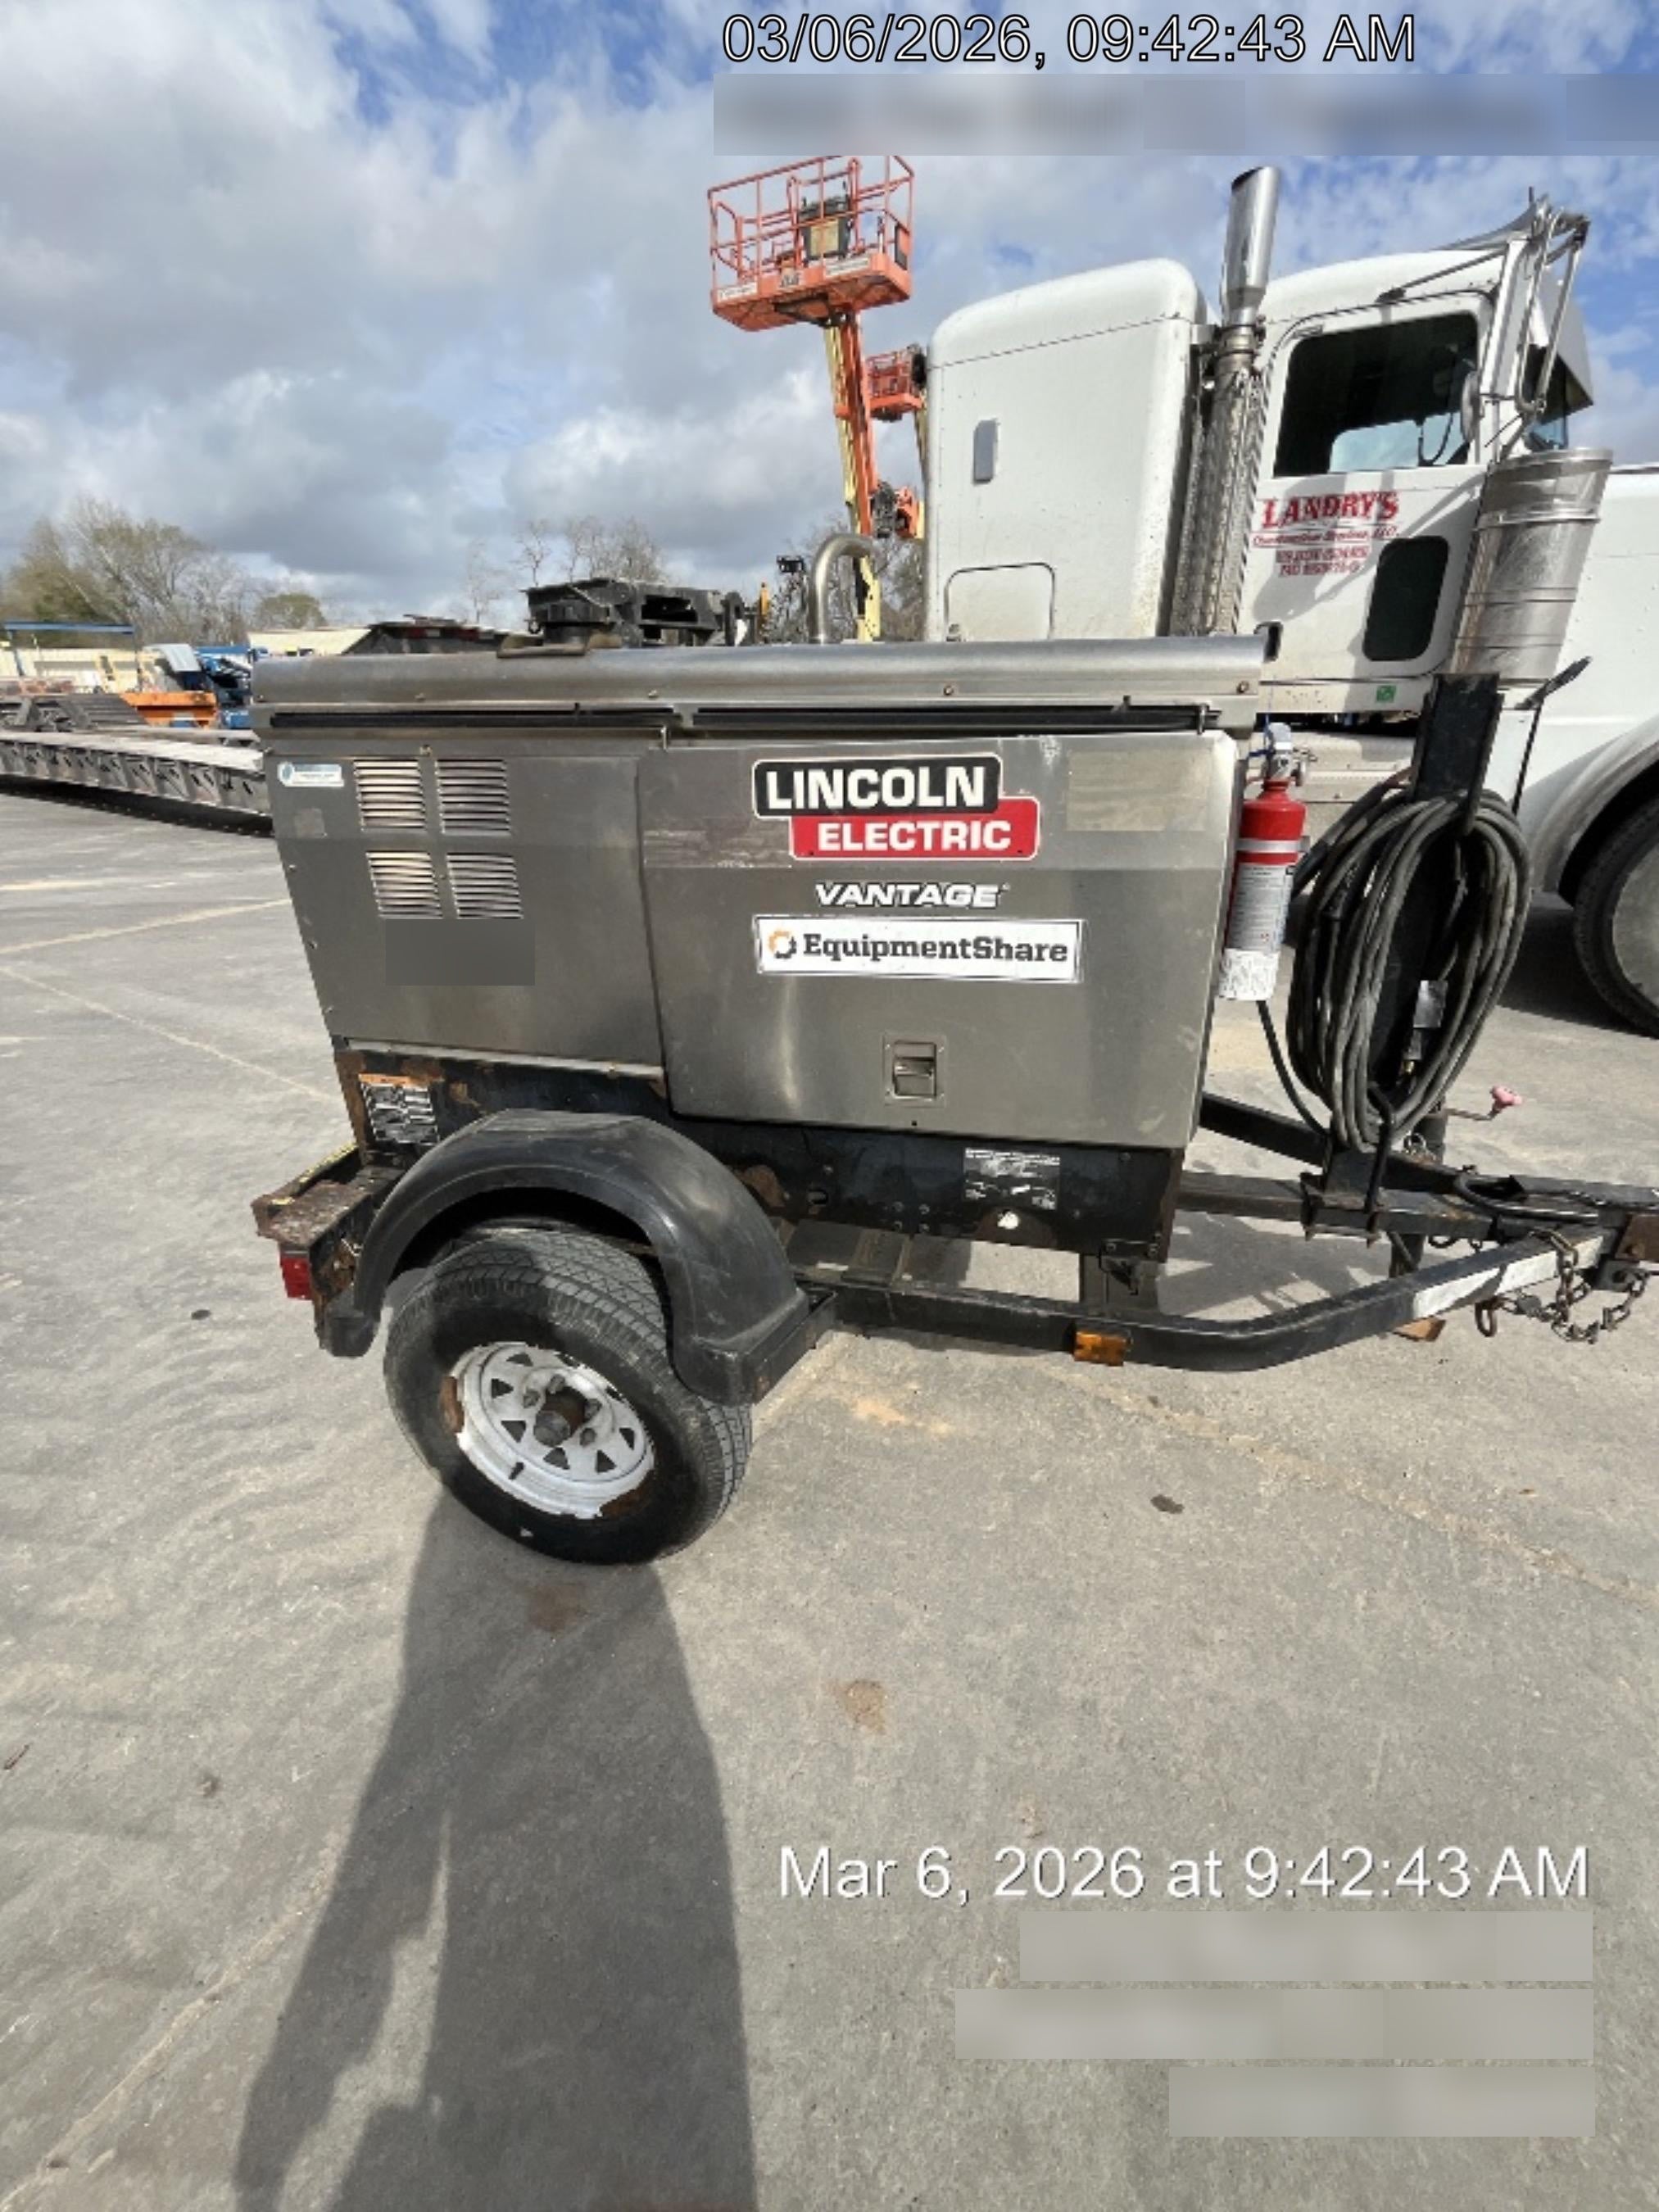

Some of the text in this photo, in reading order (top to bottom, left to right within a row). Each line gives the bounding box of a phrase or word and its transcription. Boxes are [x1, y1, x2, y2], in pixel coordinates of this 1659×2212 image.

[1261, 492, 1399, 528] LANDRY'S
[766, 765, 985, 809] LINCOLN
[817, 820, 1012, 852] ELECTRIC
[814, 882, 1000, 909] VANTAGE
[803, 932, 1068, 963] EquipmentShare
